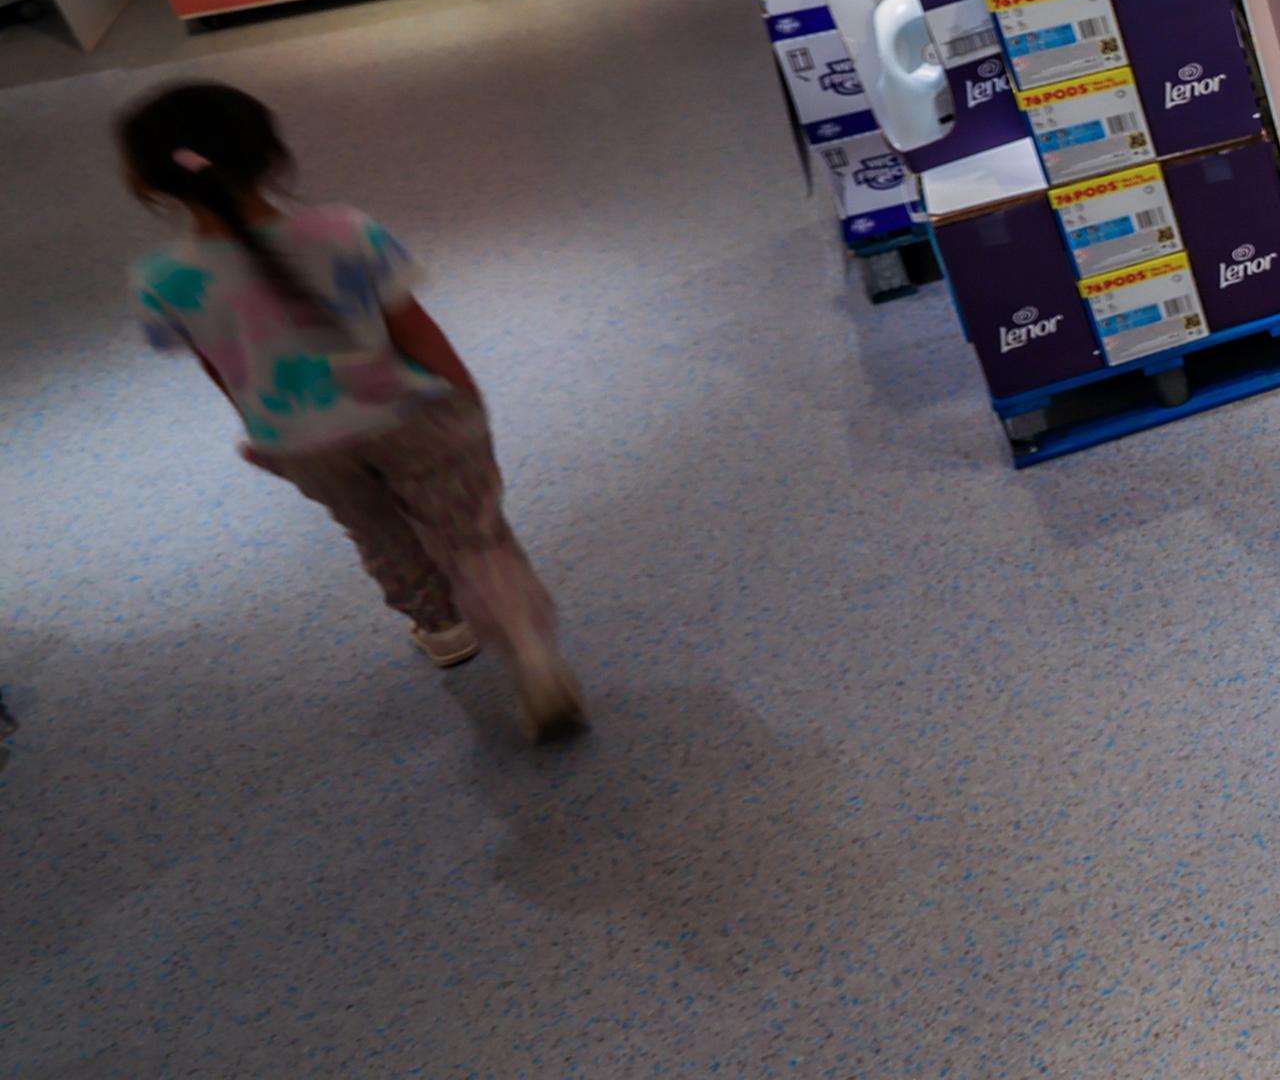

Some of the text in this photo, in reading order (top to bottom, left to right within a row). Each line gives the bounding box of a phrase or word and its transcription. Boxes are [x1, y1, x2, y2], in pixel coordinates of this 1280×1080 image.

[1164, 70, 1226, 109] Lenor
[1219, 252, 1278, 289] Lenor
[1000, 314, 1064, 354] Lenor
